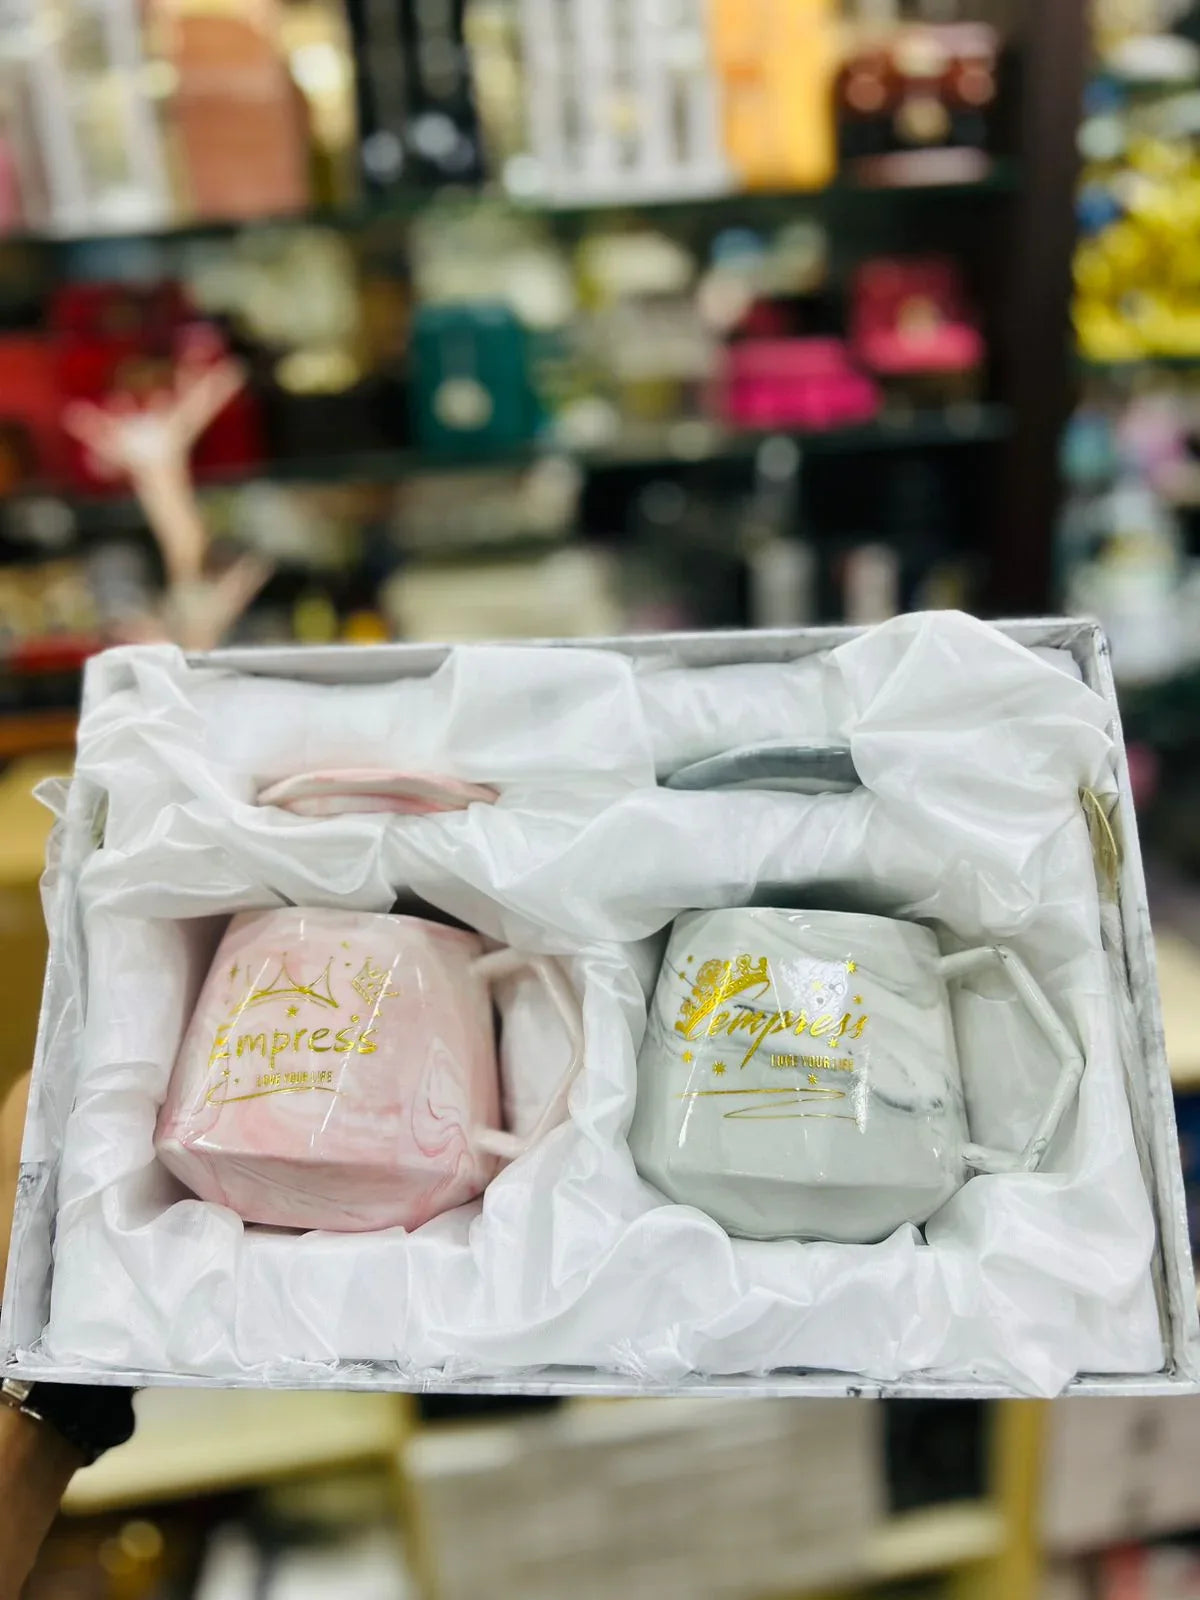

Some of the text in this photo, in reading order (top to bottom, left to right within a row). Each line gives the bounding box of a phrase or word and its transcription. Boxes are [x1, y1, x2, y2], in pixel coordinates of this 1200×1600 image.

[207, 1023, 379, 1070] Empress
[801, 1055, 830, 1069] YOUR
[256, 1070, 332, 1087] LOVE YOUR LIFE
